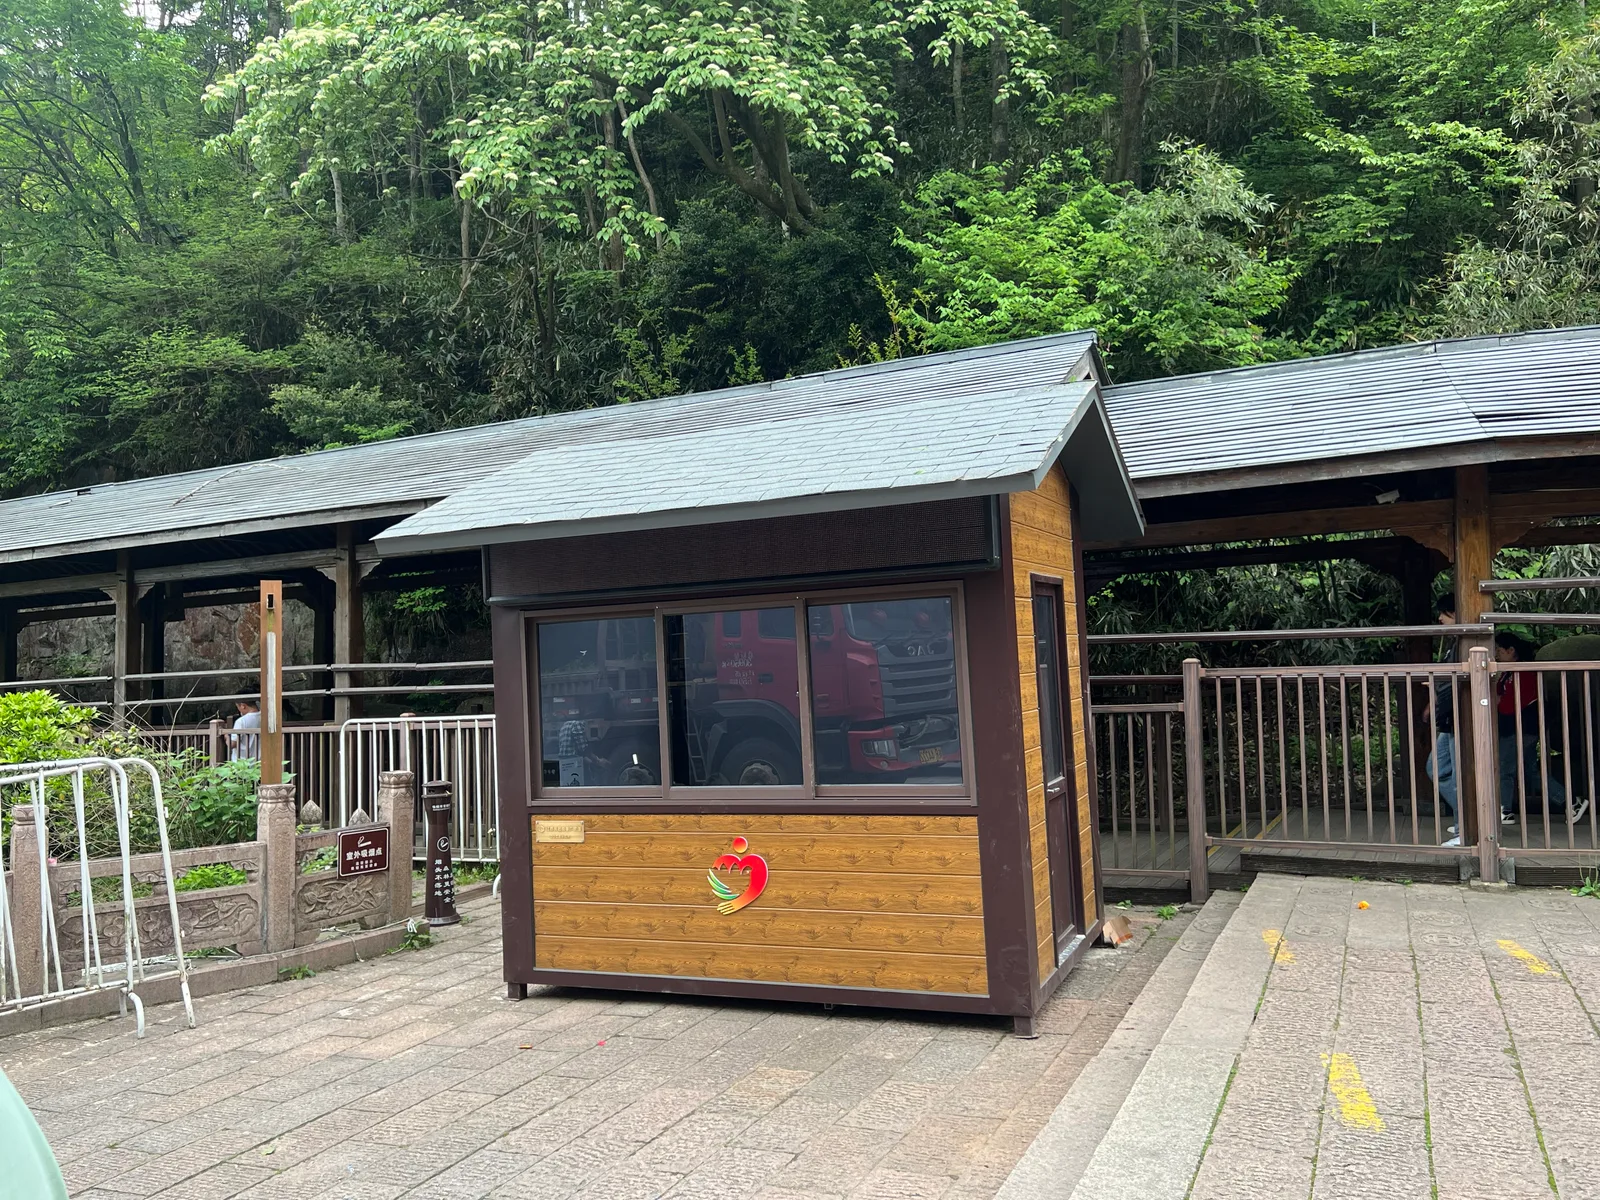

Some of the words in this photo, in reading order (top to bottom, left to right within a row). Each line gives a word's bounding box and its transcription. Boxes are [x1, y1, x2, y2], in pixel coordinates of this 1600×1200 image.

[346, 847, 382, 860] 室外吸烟点
[434, 859, 443, 896] 烟头不落地
